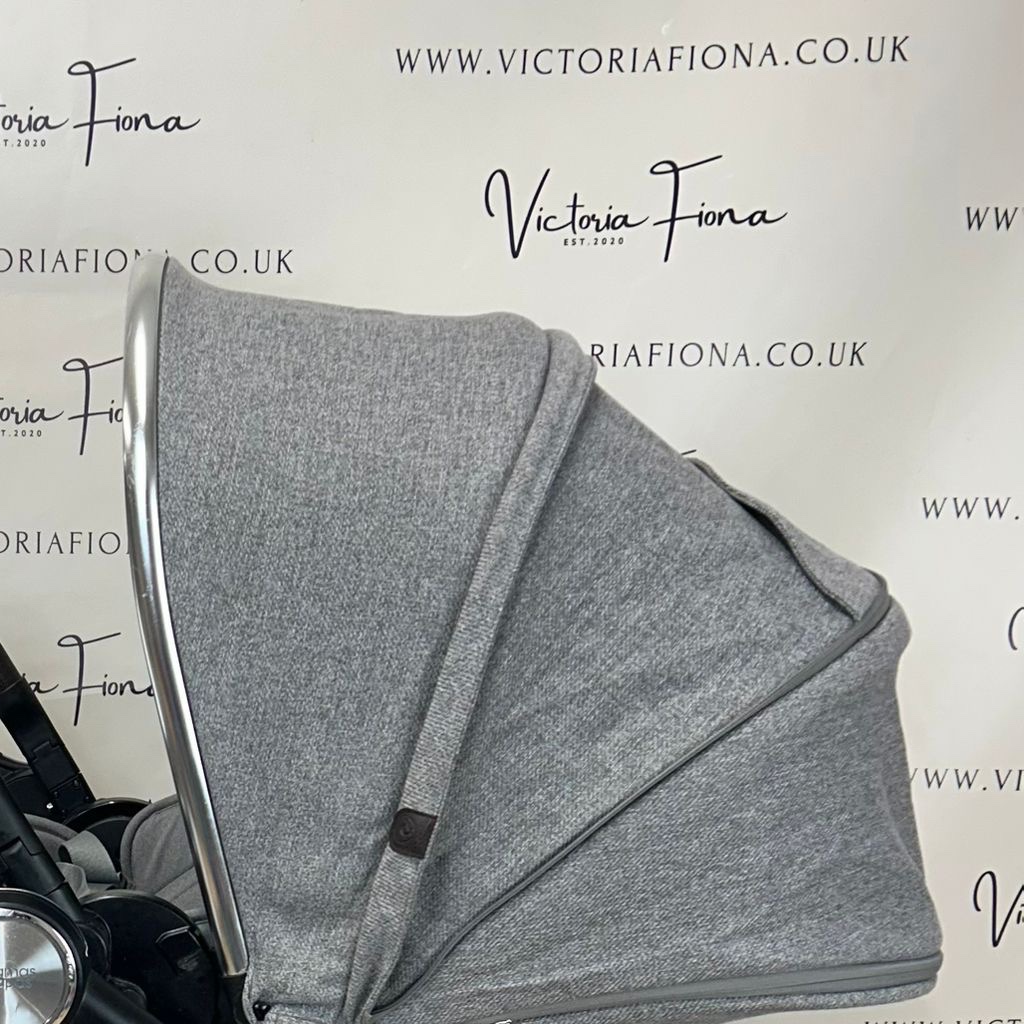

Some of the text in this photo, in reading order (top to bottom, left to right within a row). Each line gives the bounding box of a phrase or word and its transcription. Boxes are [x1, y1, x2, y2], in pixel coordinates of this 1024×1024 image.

[396, 36, 909, 75] WWW.VICTORIAFIONA.CO.UK
[67, 58, 201, 167] Fiona
[485, 155, 788, 263] Victoria Fiona
[564, 238, 624, 246] EST.2020
[591, 342, 867, 367] RIAFIONA.CO.UK
[61, 357, 123, 455] Fio
